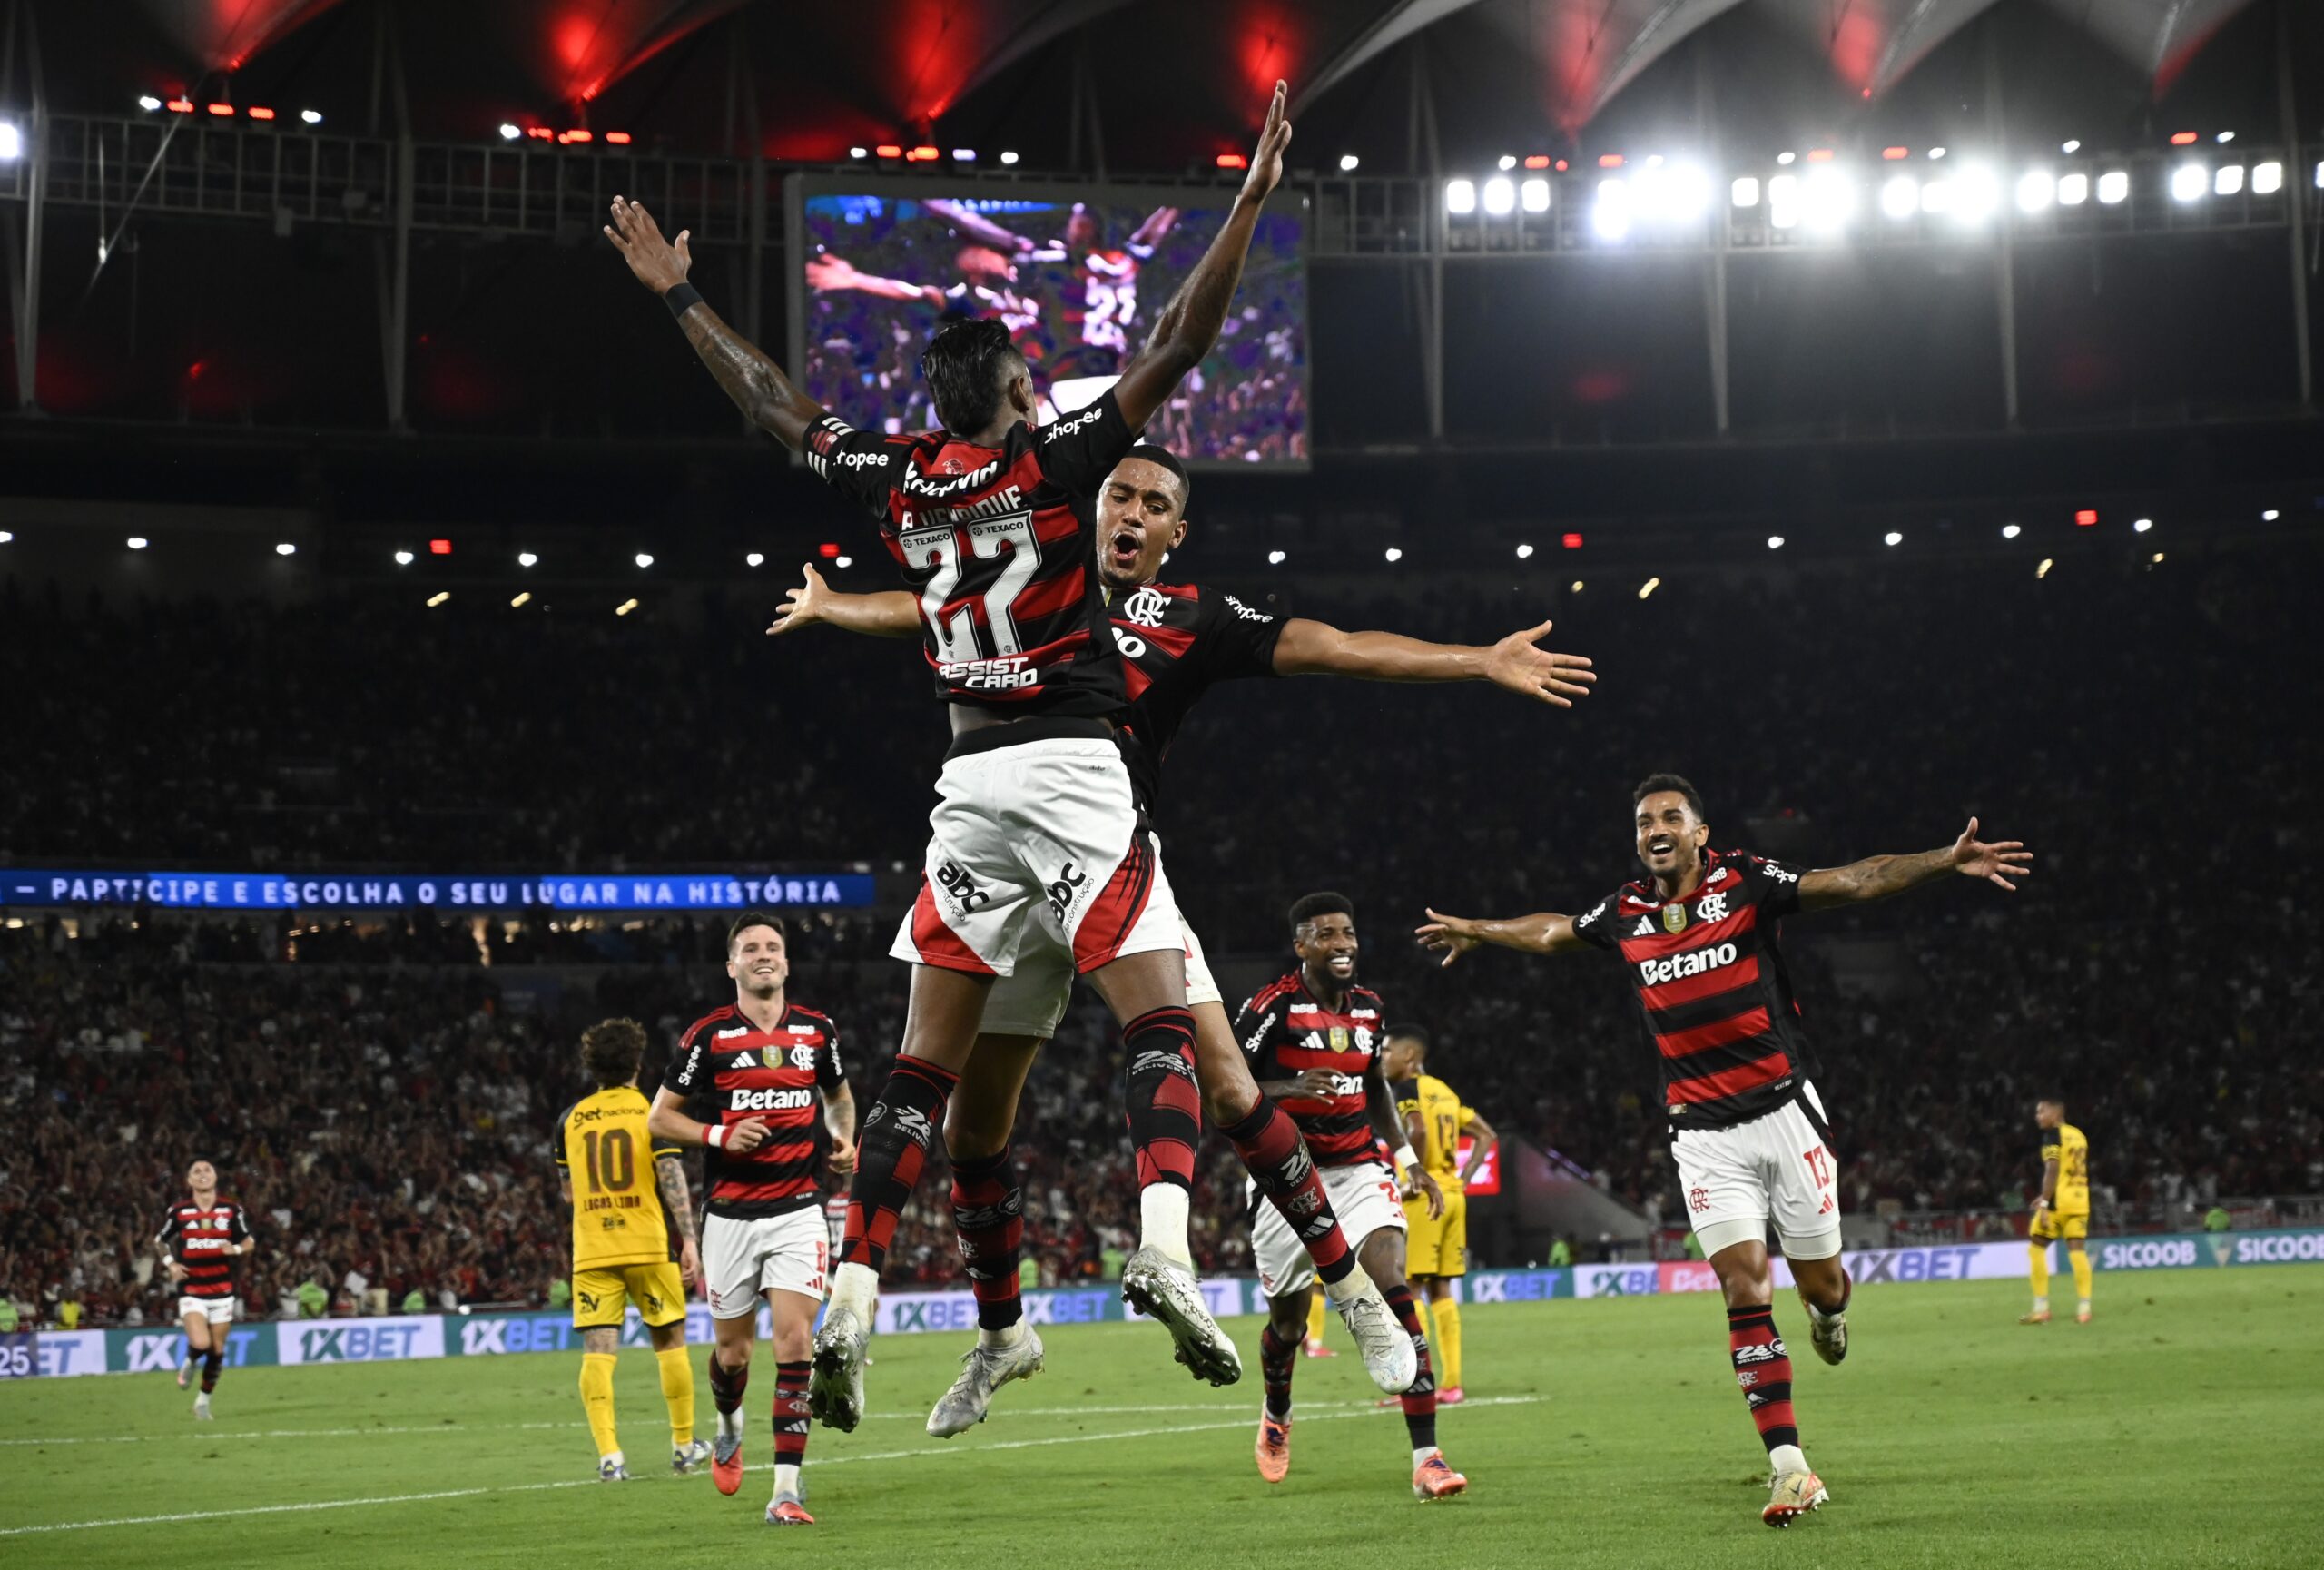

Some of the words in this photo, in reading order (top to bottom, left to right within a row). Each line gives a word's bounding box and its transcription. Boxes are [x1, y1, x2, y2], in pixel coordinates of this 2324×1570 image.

[913, 533, 950, 546] TEXACO
[985, 522, 1024, 534] TEXACO
[899, 510, 1042, 665] 27
[939, 657, 1029, 679] ASSIST
[965, 668, 1037, 688] CARD
[234, 881, 249, 902] E
[263, 880, 405, 903] ESCOLHA
[418, 882, 437, 904] O
[452, 882, 507, 903] SEU
[522, 882, 618, 904] LUGAR
[634, 883, 675, 903] NA
[688, 875, 841, 903] HISTÓRIA
[937, 861, 990, 913] abc
[1640, 943, 1738, 986] Betano
[1246, 1012, 1277, 1052] Shopee
[677, 1045, 702, 1086] Shopee
[730, 1089, 812, 1111] Betano
[583, 1128, 635, 1194] 10
[1803, 1145, 1830, 1190] 13
[584, 1198, 612, 1212] LUCAS
[615, 1195, 641, 1209] LIMA
[1849, 1248, 1981, 1283] 1XBET
[2103, 1239, 2197, 1269] SICOOB
[1472, 1271, 1561, 1304] 1XBET
[300, 1324, 421, 1361] 1XBET
[460, 1317, 574, 1354] 1XBET
